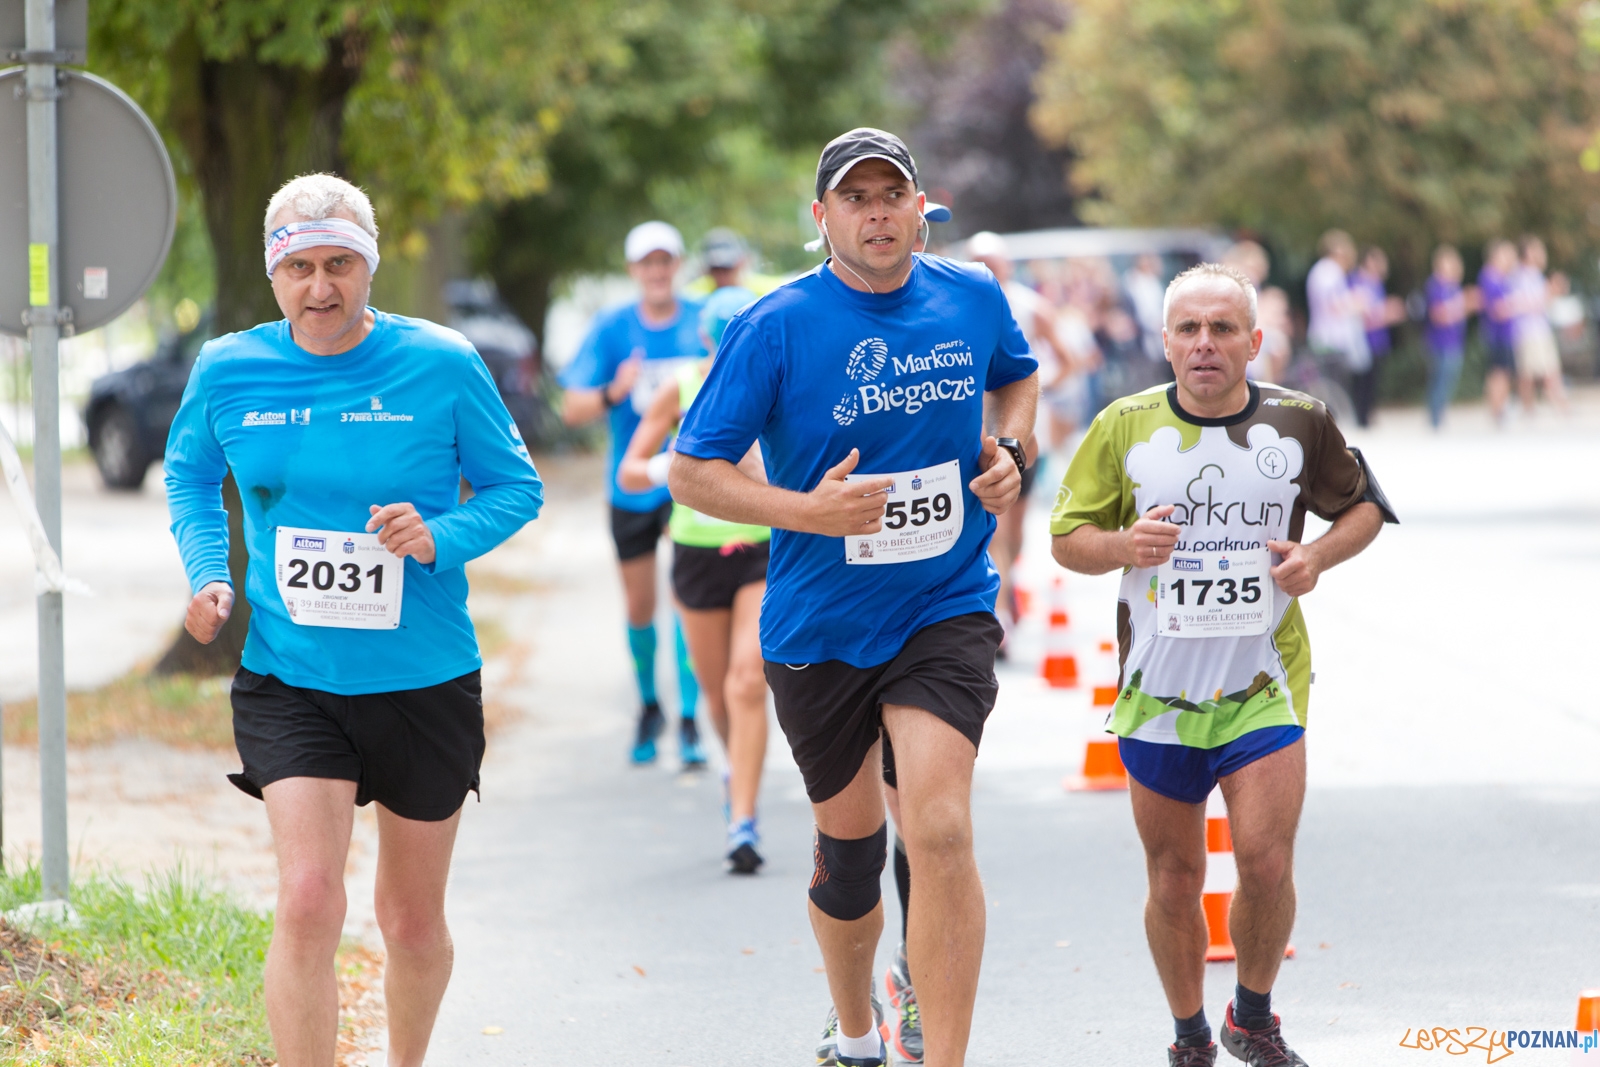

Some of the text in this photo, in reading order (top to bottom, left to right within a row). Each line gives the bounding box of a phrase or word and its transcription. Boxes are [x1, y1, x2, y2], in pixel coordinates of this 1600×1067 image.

[935, 340, 959, 351] CRAFT
[891, 346, 974, 376] Markowi
[858, 376, 976, 415] Biegacze
[340, 412, 355, 422] 37
[354, 414, 373, 422] BIEG
[374, 413, 414, 422] LECHITÓW
[885, 493, 952, 530] 559
[876, 540, 888, 548] 39
[890, 537, 913, 547] BIEG
[915, 527, 955, 544] LECHITÓW
[287, 558, 384, 594] 2031
[1170, 576, 1262, 606] 1735
[300, 599, 312, 608] 39
[314, 600, 337, 610] BIEG
[340, 602, 389, 613] LECHITÓW
[1183, 614, 1195, 623] 39
[1196, 614, 1218, 623] BIEG
[1221, 610, 1264, 621] LECHITÓW
